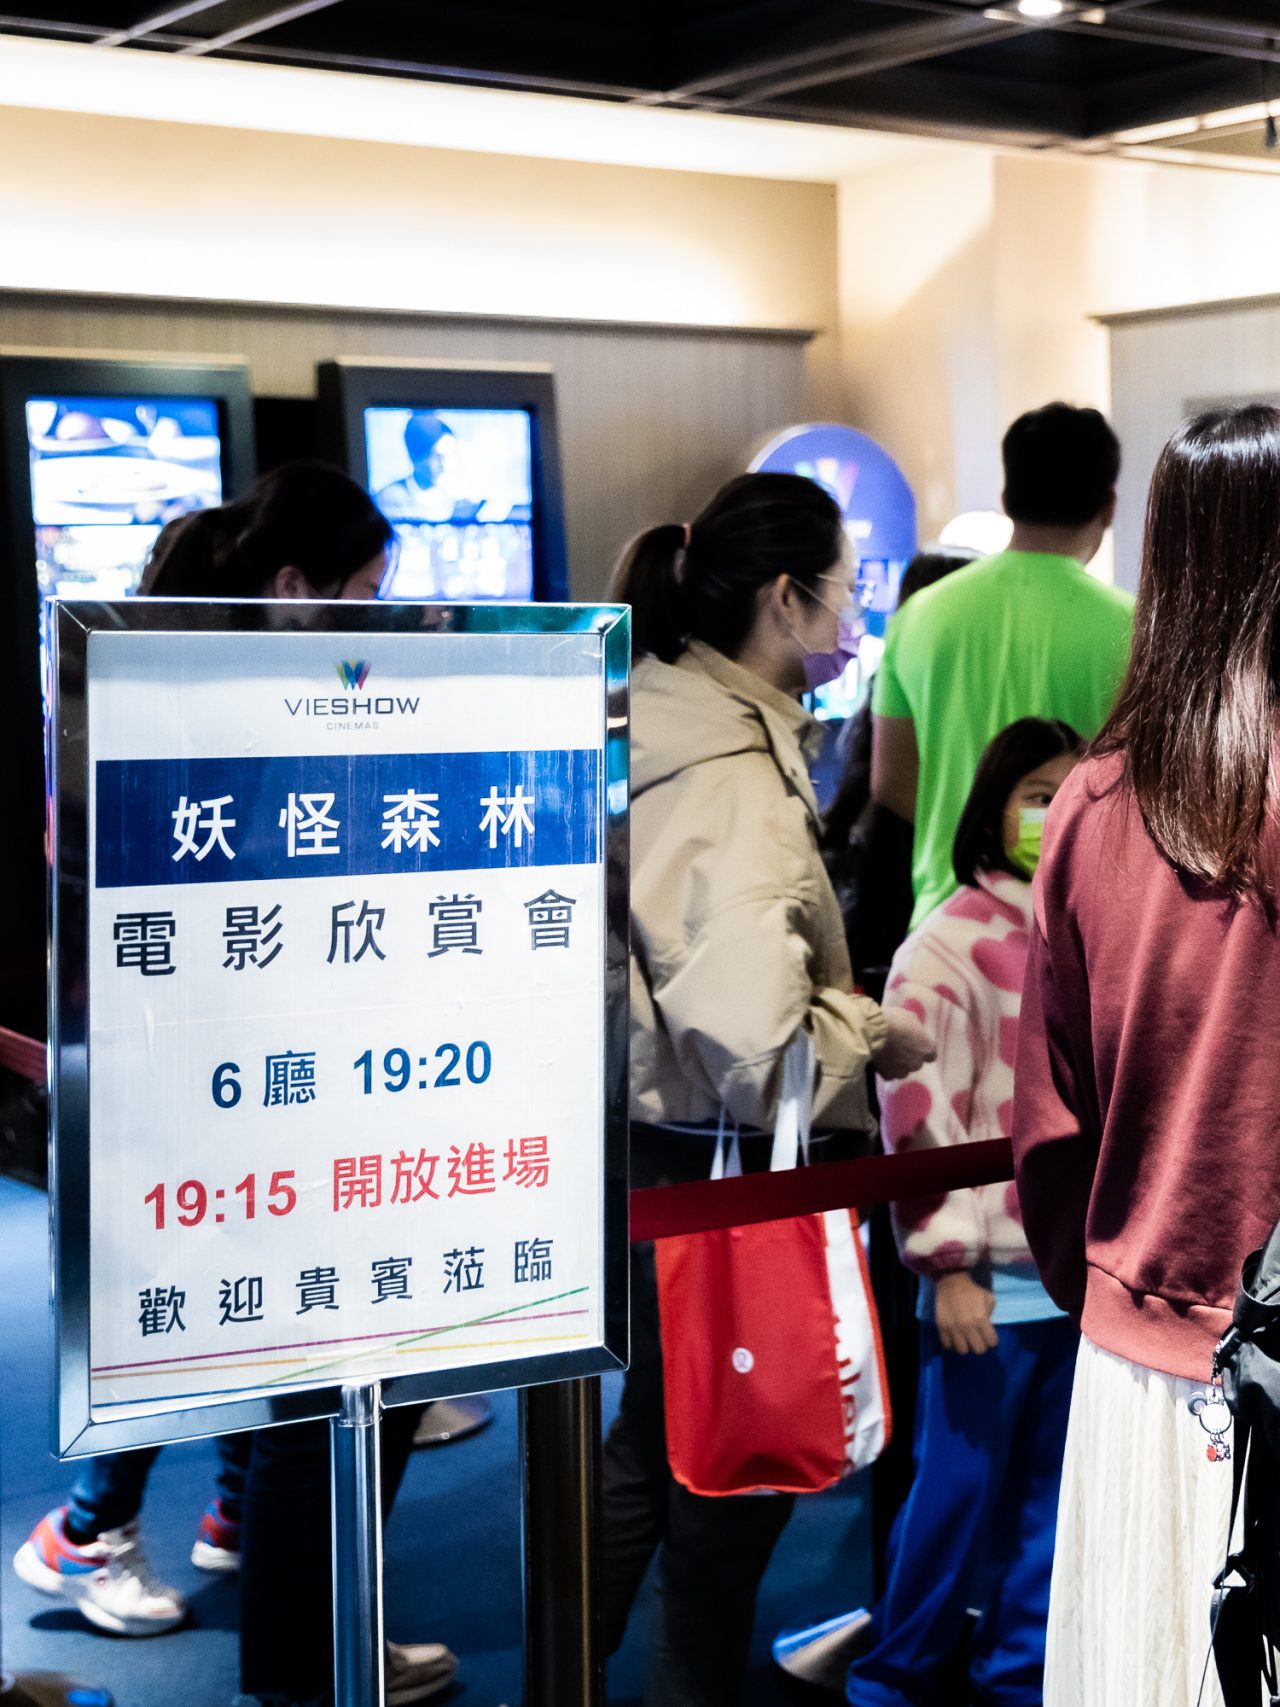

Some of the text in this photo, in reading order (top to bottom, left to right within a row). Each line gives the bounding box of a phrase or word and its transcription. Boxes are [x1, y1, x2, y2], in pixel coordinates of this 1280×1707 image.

[284, 697, 421, 716] VIESHOW
[326, 721, 380, 731] CINEMAS
[171, 784, 536, 863] 妖怪森林
[113, 888, 578, 977] 電影欣賞會
[353, 1039, 493, 1096] 19:20
[144, 1135, 552, 1231] 19:15 開放進場
[138, 1237, 555, 1337] 歡迎貴賓蒞臨
